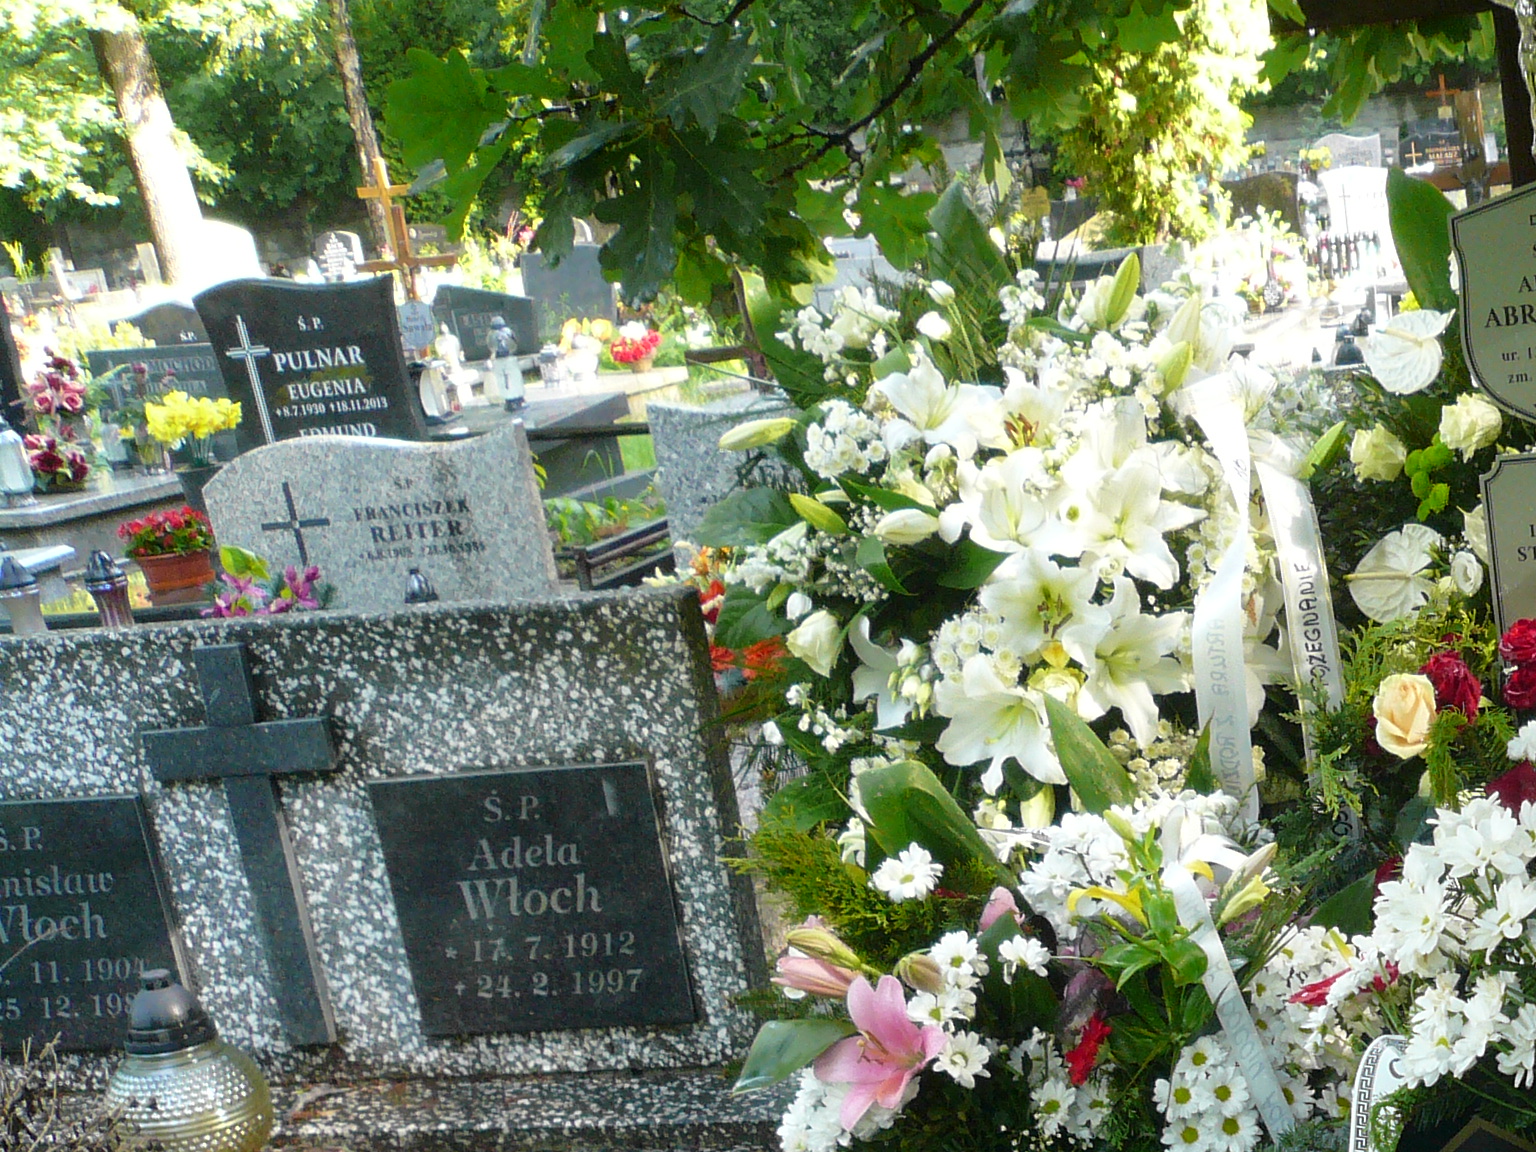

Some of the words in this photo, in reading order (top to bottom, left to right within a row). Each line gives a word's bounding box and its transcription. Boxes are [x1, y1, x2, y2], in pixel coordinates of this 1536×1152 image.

[272, 345, 366, 373] PULNAR
[287, 377, 367, 400] EUGENIA
[352, 500, 470, 522] FRANCISZEK
[370, 520, 464, 544] REITER
[467, 834, 582, 872] Adela
[0, 864, 115, 898] nisław
[564, 931, 637, 959] 1912
[572, 968, 643, 995] 1997
